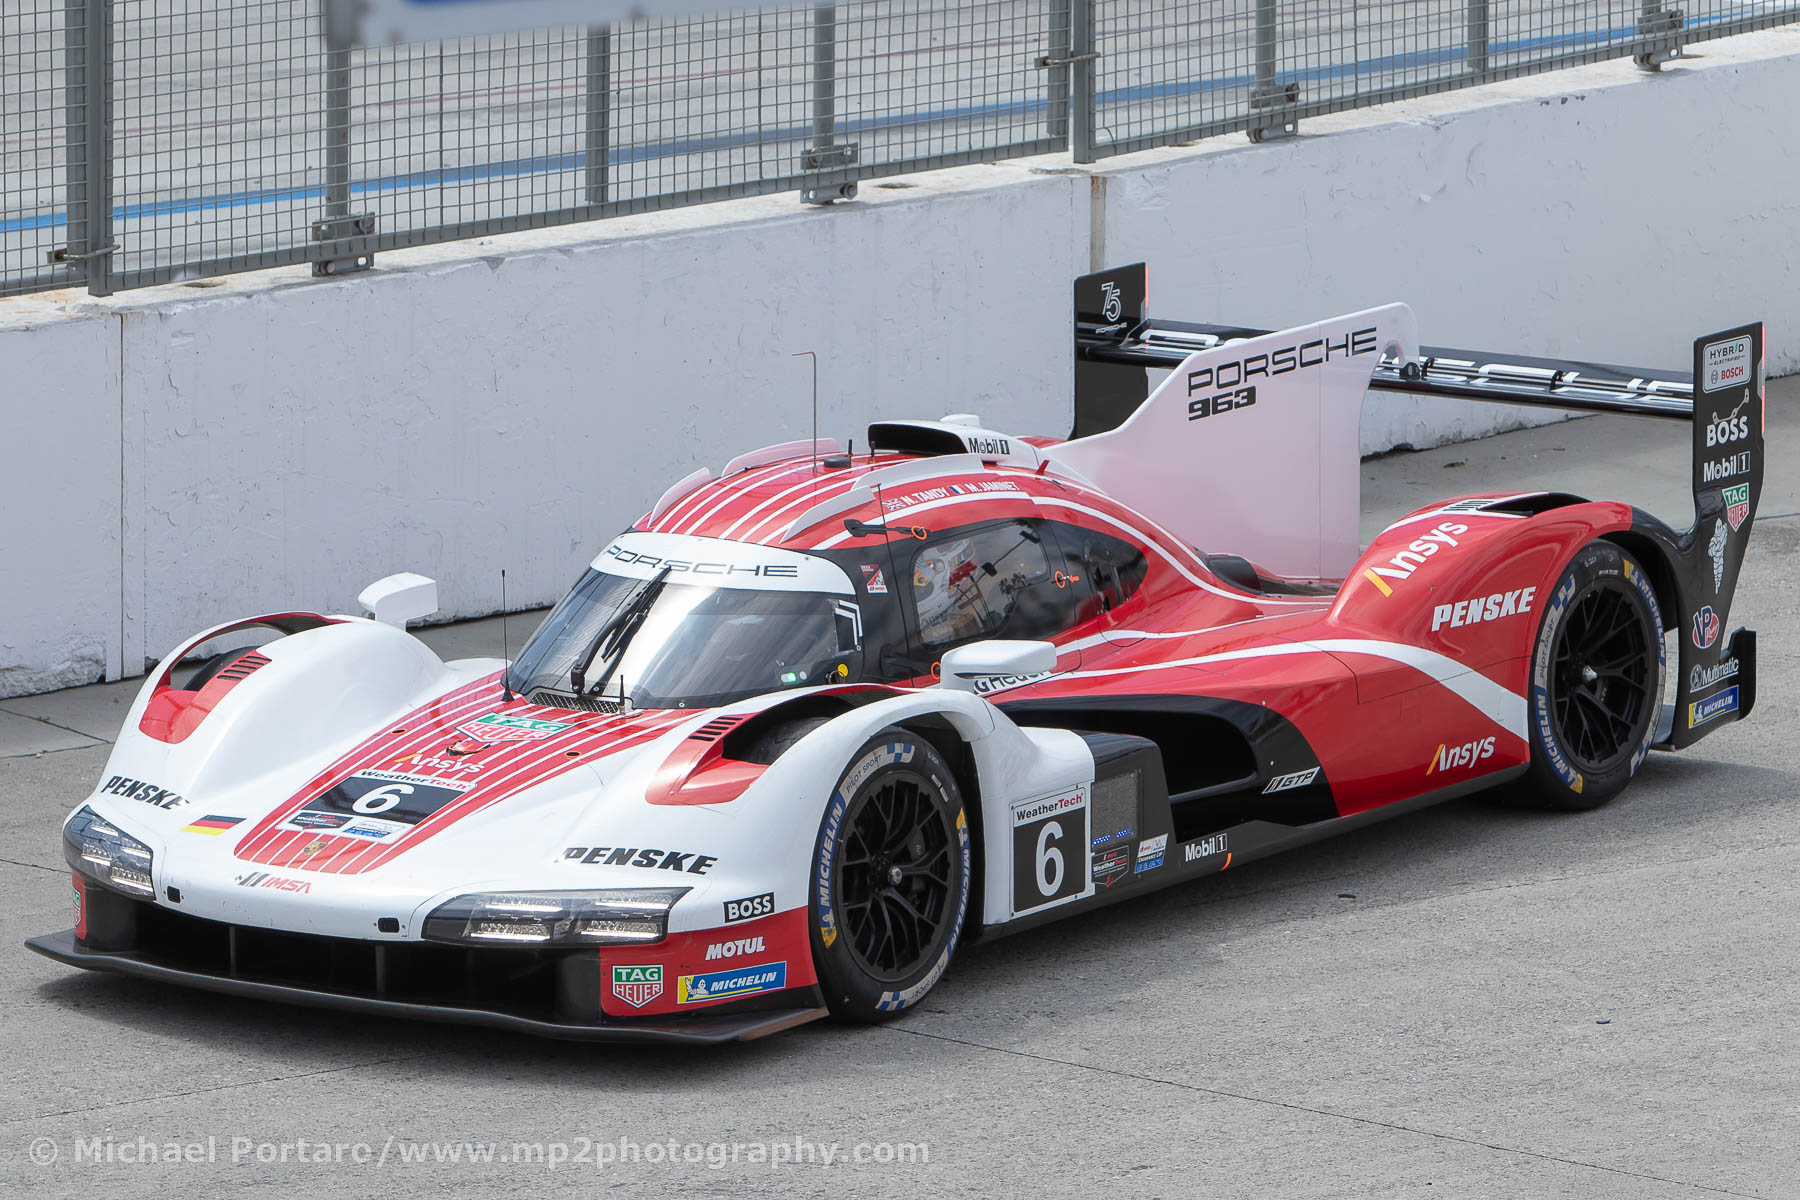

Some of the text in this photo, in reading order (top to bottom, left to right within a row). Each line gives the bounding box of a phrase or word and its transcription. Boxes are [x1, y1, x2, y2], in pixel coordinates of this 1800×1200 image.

[1101, 281, 1122, 322] 75
[1187, 326, 1377, 397] PORSCHE
[1709, 342, 1745, 360] HYBRID
[1721, 365, 1744, 380] BOSCH
[1187, 385, 1257, 421] 963
[1706, 415, 1749, 448] BOSS
[967, 437, 998, 455] Mobil
[1703, 454, 1737, 483] Mobil
[904, 487, 950, 506] N. TANDY
[964, 481, 1021, 494] M. JAMINET
[1724, 487, 1746, 505] TAG
[603, 544, 798, 578] PORSCHE
[1362, 521, 1469, 598] Ansys
[1431, 585, 1537, 632] PENSKE
[1638, 580, 1666, 658] MICHELIN
[1692, 606, 1712, 648] VP
[1702, 656, 1739, 686] Multimatic
[1703, 695, 1734, 715] MICHELIN
[463, 723, 547, 740] HEUER
[488, 715, 565, 731] TAG
[1537, 694, 1569, 775] MICHELIN
[394, 753, 486, 773] Ansys
[862, 754, 882, 775] SPORT
[1425, 736, 1496, 776] Ansys
[360, 769, 468, 790] WeatherTech
[846, 770, 863, 794] PILOT
[1281, 770, 1315, 788] GTP
[100, 775, 191, 810] PENSKE
[351, 783, 415, 814] 6
[1016, 793, 1084, 821] WeatherTech
[554, 847, 719, 876] PENSKE
[819, 802, 844, 907] MICHELIN
[1035, 820, 1065, 897] 6
[1184, 837, 1216, 862] Mobil
[260, 877, 312, 894] IMSA
[727, 894, 772, 920] BOSS
[705, 936, 766, 961] MOTUL
[616, 967, 659, 982] TAG
[710, 971, 777, 992] MICHELIN
[616, 983, 661, 1005] HEUER
